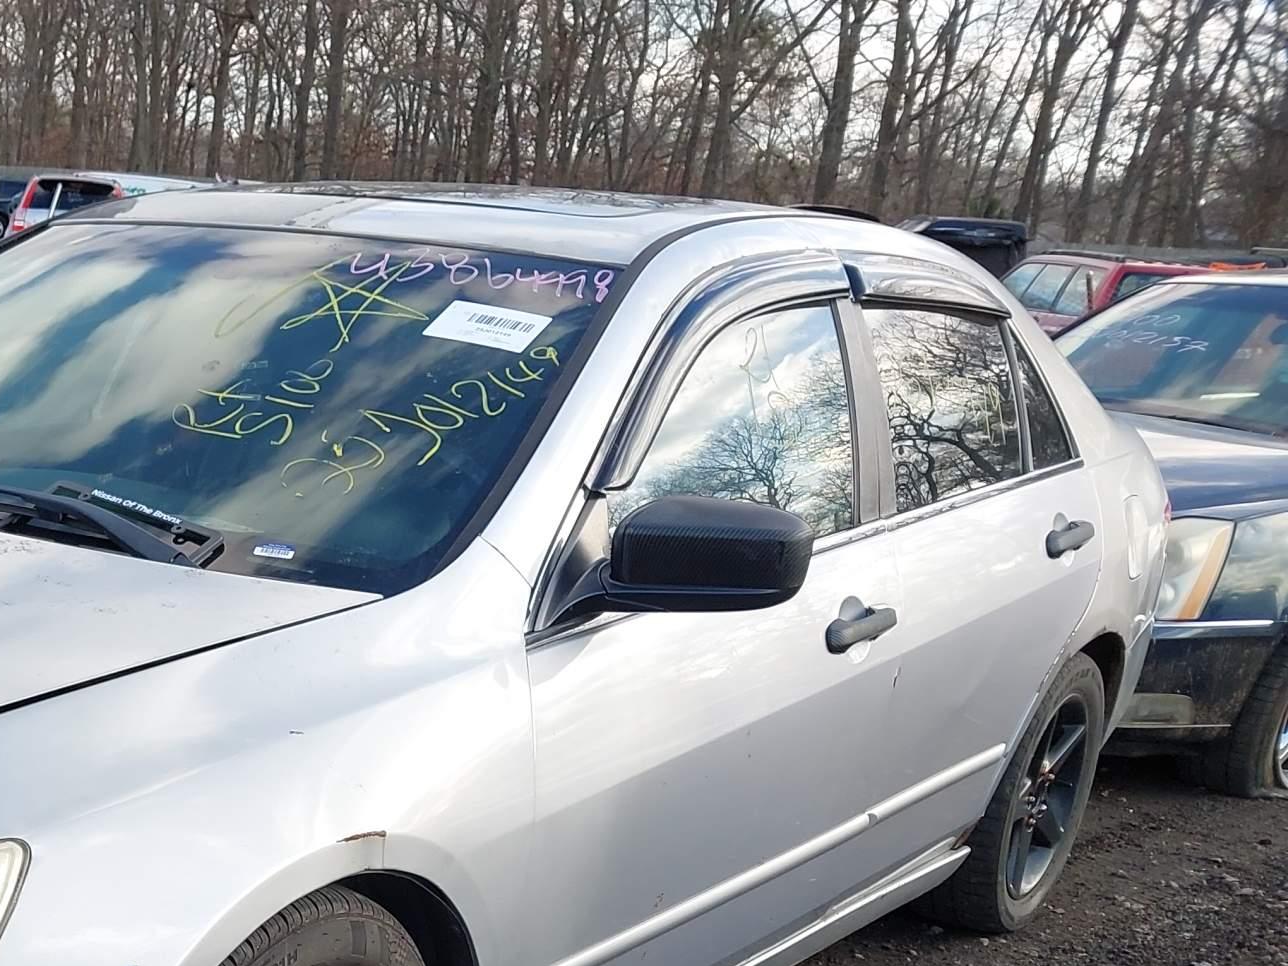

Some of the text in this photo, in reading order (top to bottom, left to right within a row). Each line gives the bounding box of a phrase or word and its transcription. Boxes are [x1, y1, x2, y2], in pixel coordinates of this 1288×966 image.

[91, 489, 183, 525] Nissan Of The Bronx
